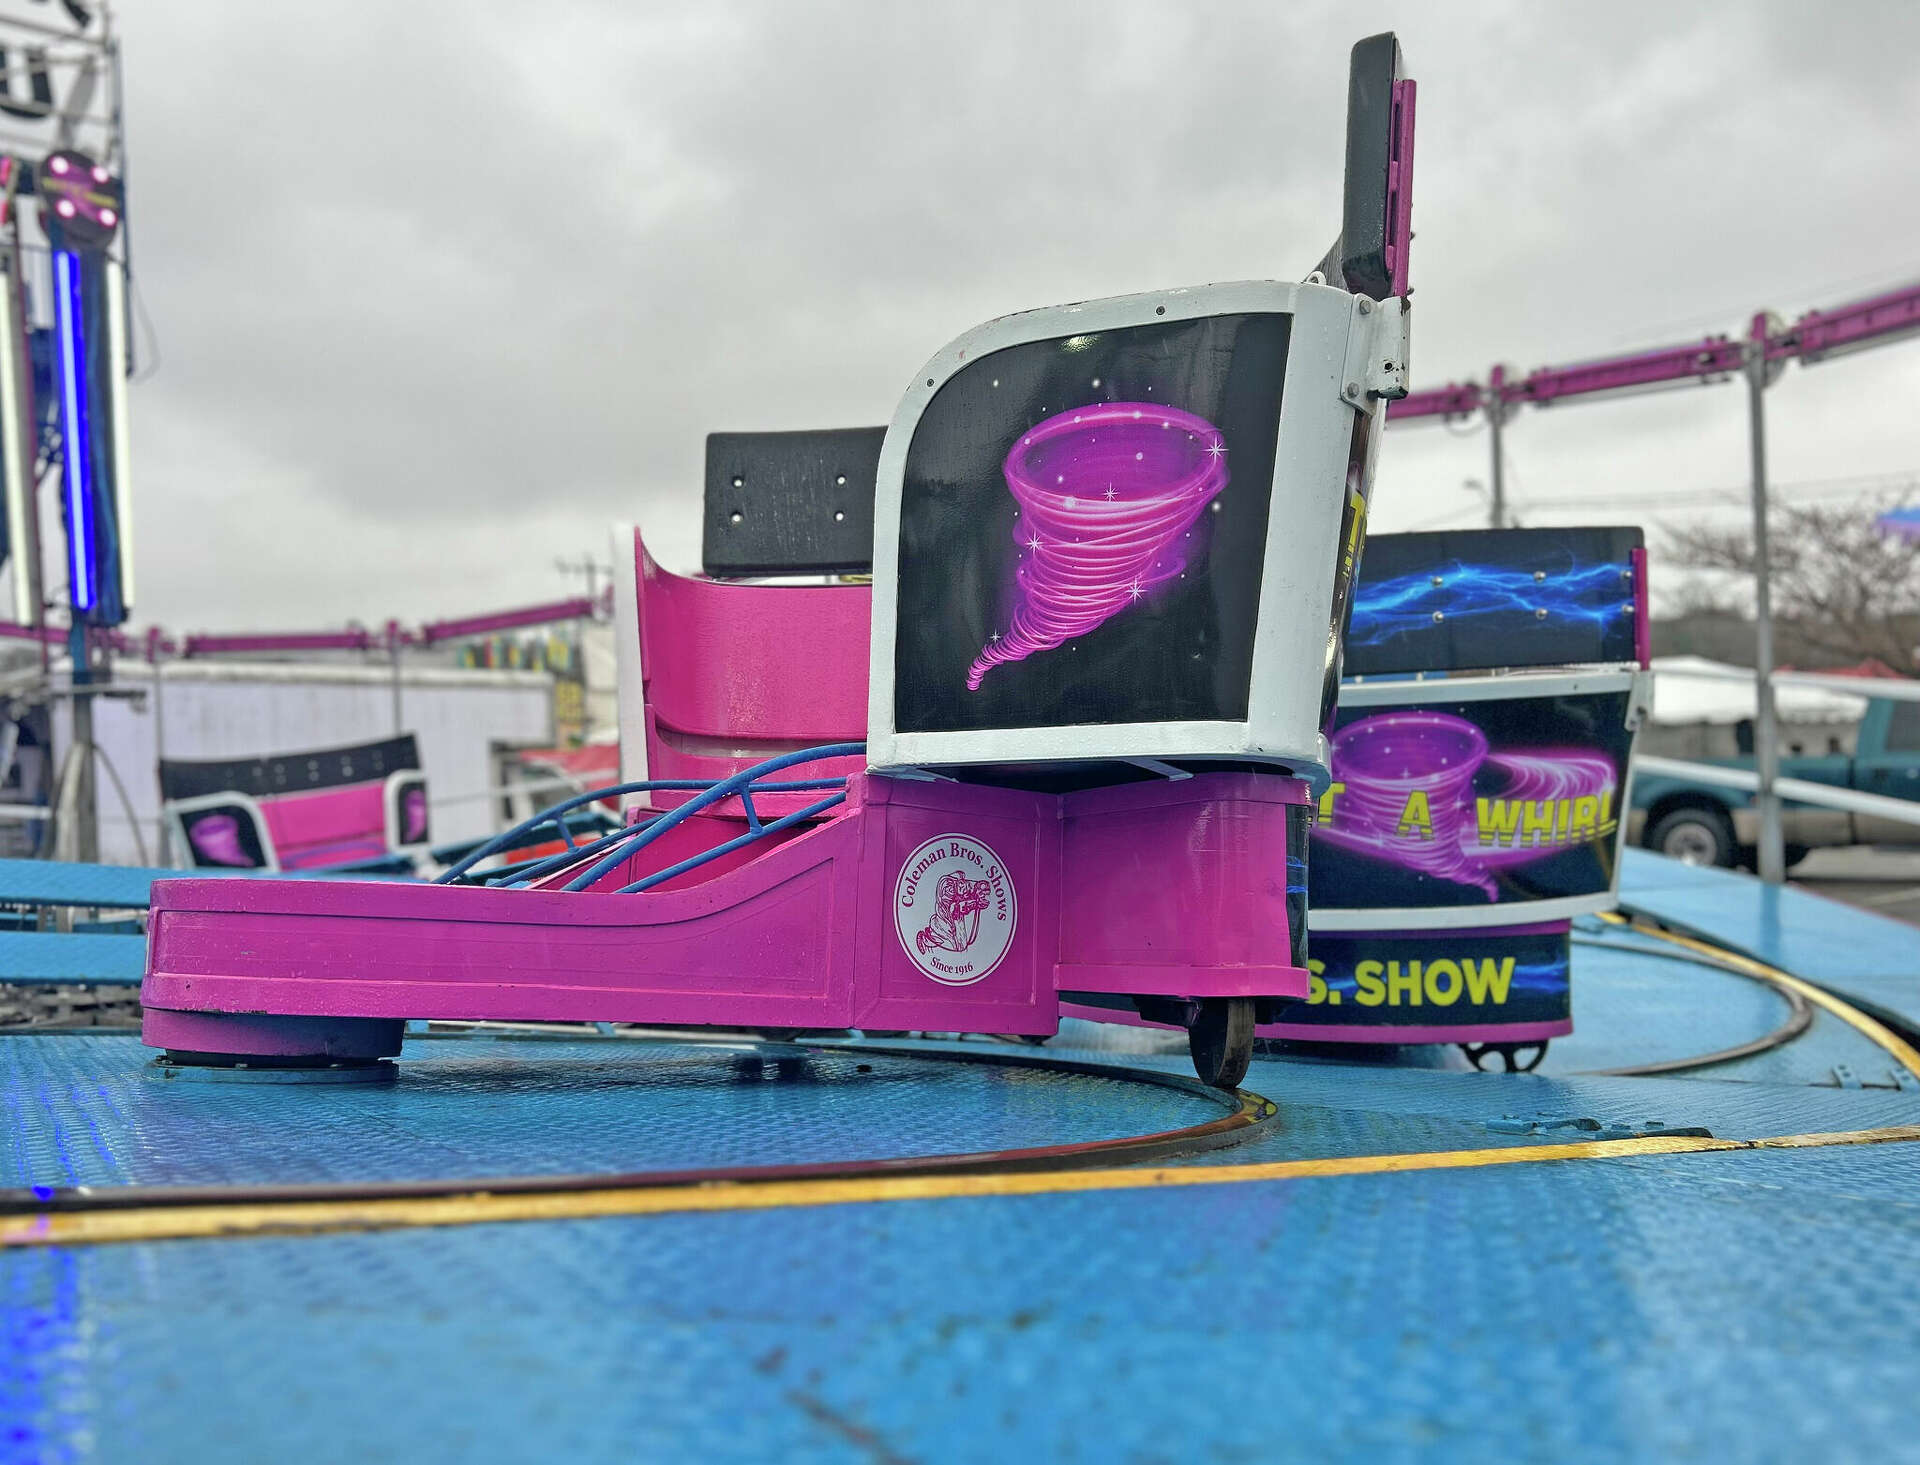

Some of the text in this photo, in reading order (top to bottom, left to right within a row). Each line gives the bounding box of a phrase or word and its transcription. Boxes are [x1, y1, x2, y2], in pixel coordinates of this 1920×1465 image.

[1395, 790, 1435, 840] A
[1476, 788, 1617, 847] WHIRL
[902, 842, 1007, 921] Coleman Bros. Shows
[930, 956, 974, 976] Since 1916
[1355, 957, 1515, 1006] SHOW
